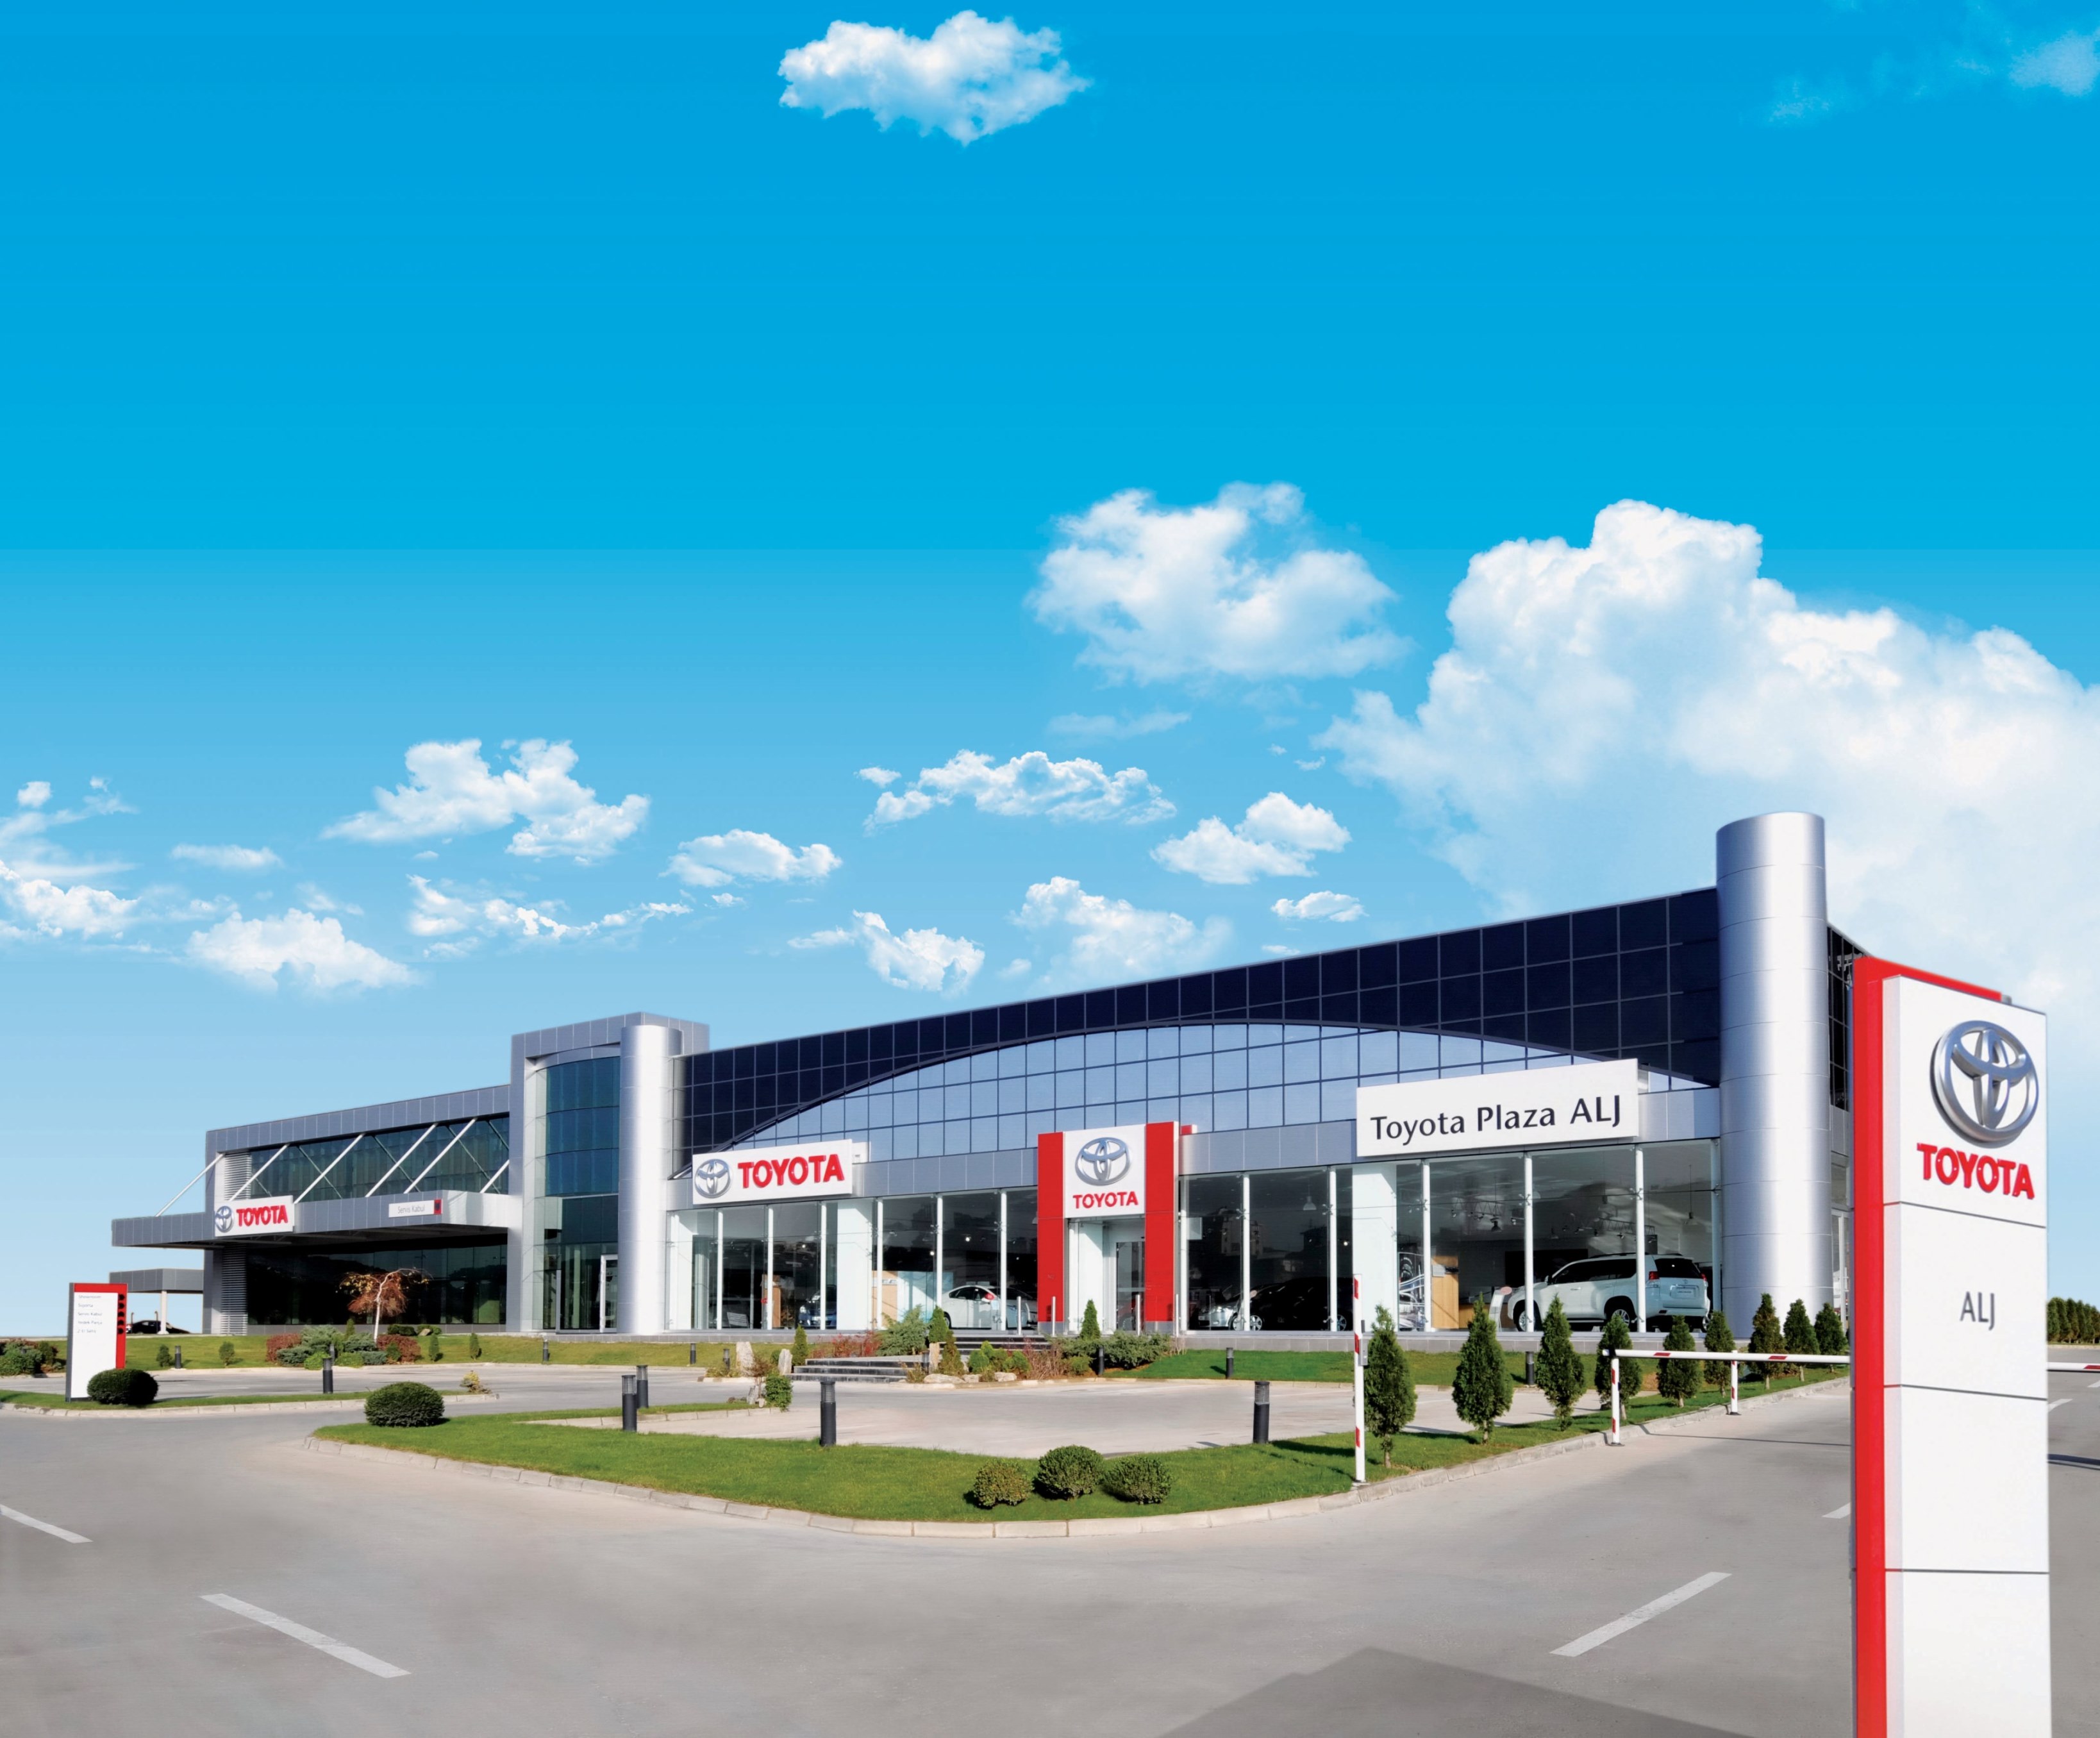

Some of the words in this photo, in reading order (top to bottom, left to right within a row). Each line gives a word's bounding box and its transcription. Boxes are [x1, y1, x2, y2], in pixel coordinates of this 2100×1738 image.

[1371, 1112, 1465, 1146] Toyota
[1478, 1104, 1556, 1132] Plaza
[1570, 1095, 1621, 1126] ALJ
[738, 1154, 844, 1188] TOYOTA
[1917, 1143, 2035, 1199] TOYOTA
[236, 1205, 288, 1227] TOYOTA
[1072, 1191, 1138, 1209] TOYOTA
[1960, 1292, 1995, 1330] ALJ
